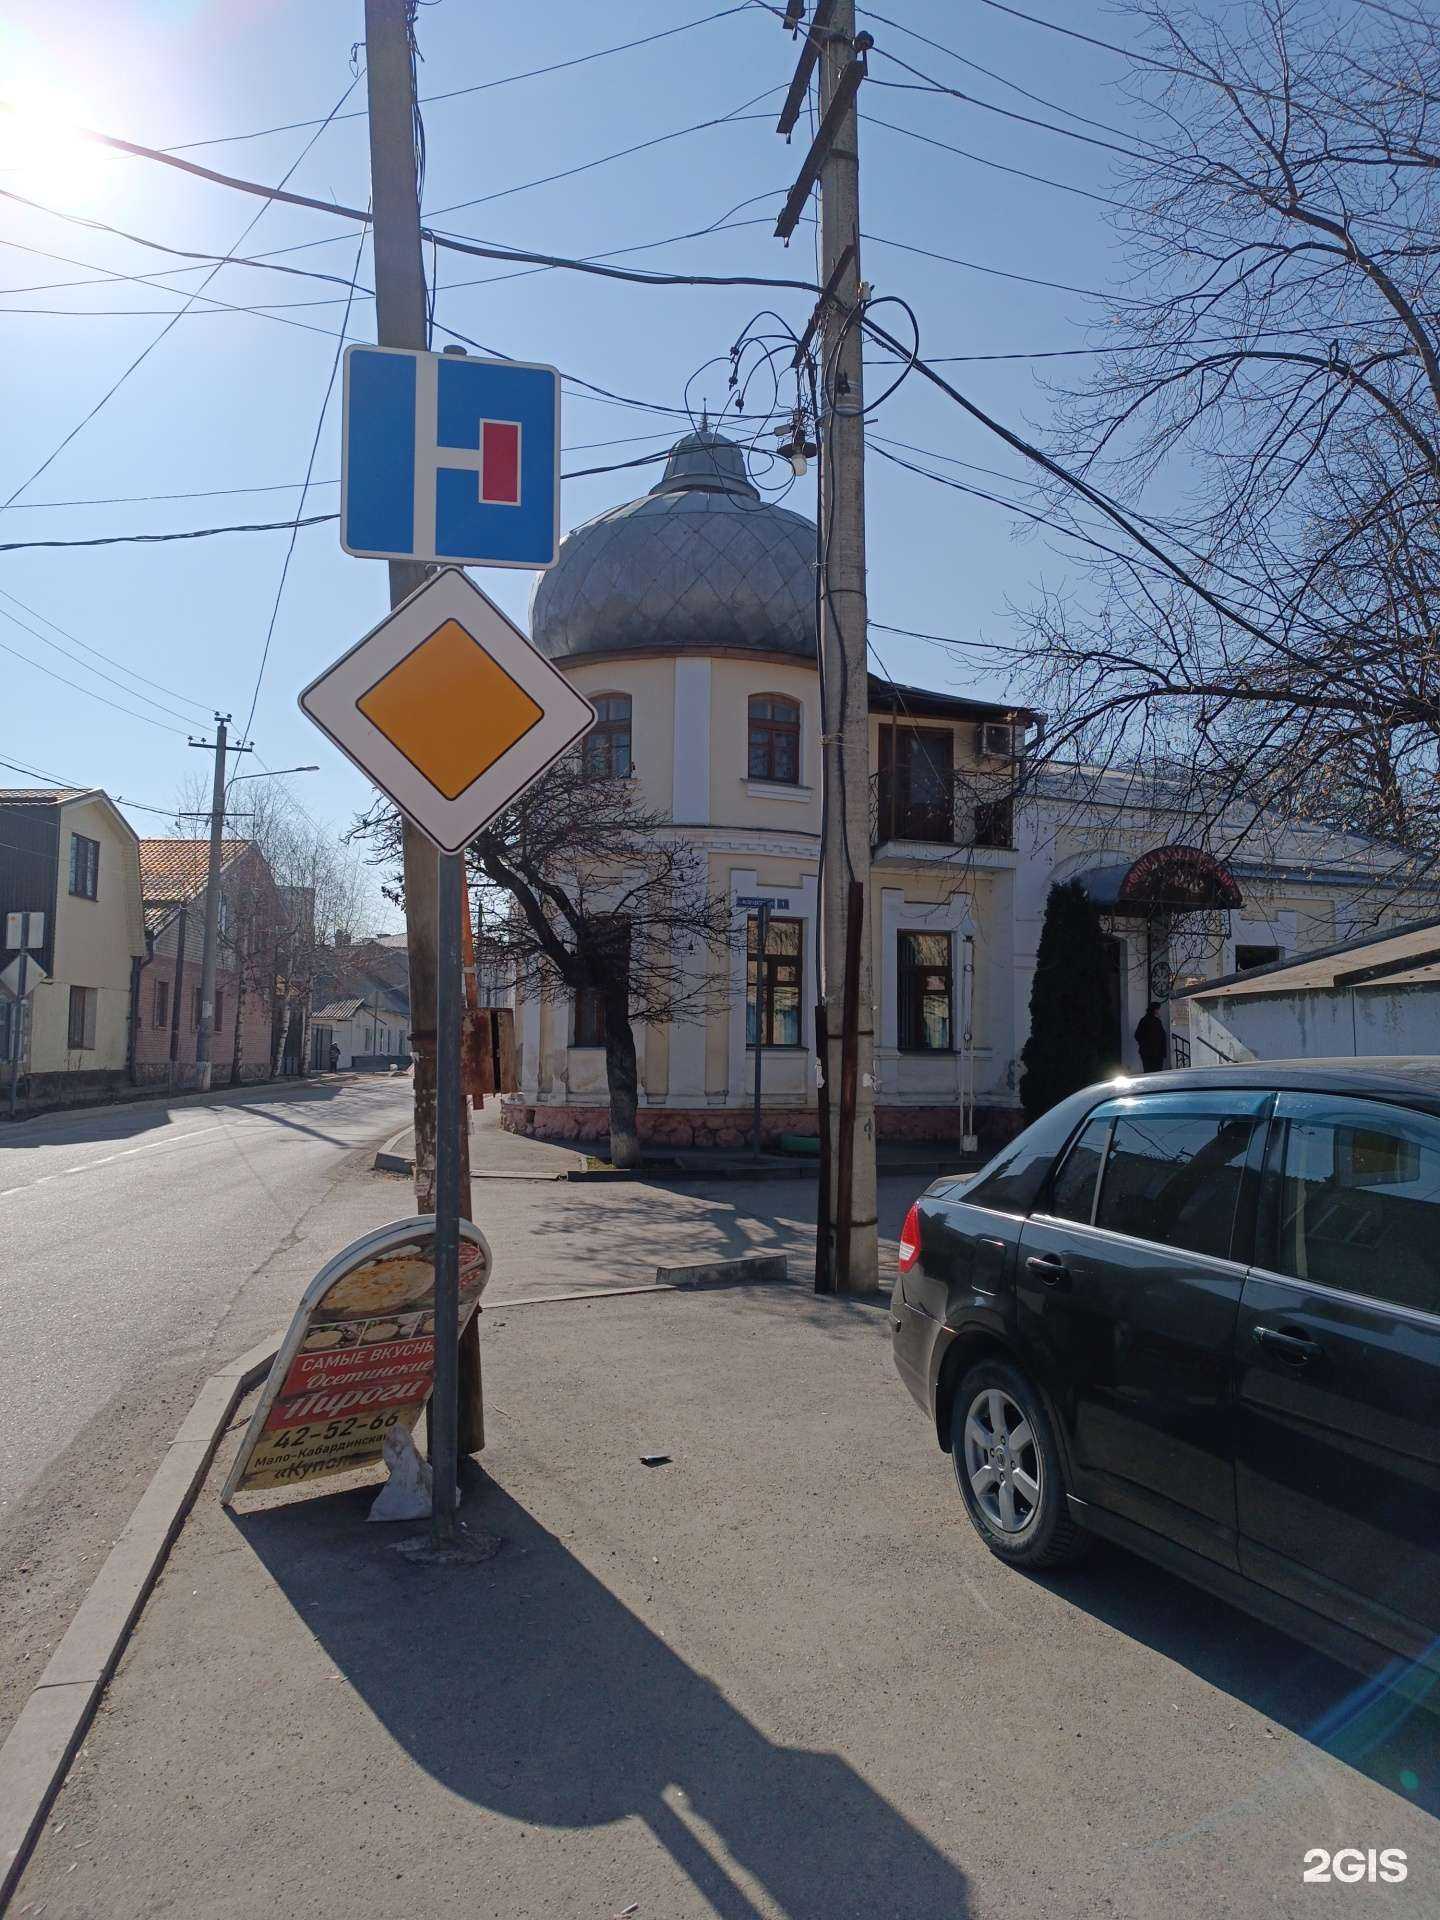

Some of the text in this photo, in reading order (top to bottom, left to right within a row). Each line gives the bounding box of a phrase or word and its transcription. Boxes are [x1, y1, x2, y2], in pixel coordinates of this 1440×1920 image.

[301, 1340, 435, 1372] САМЫЕ ВКУСНЫ
[305, 1359, 435, 1389] Осетинские
[281, 1380, 420, 1420] Пироги
[272, 1412, 400, 1449] 42-52-66
